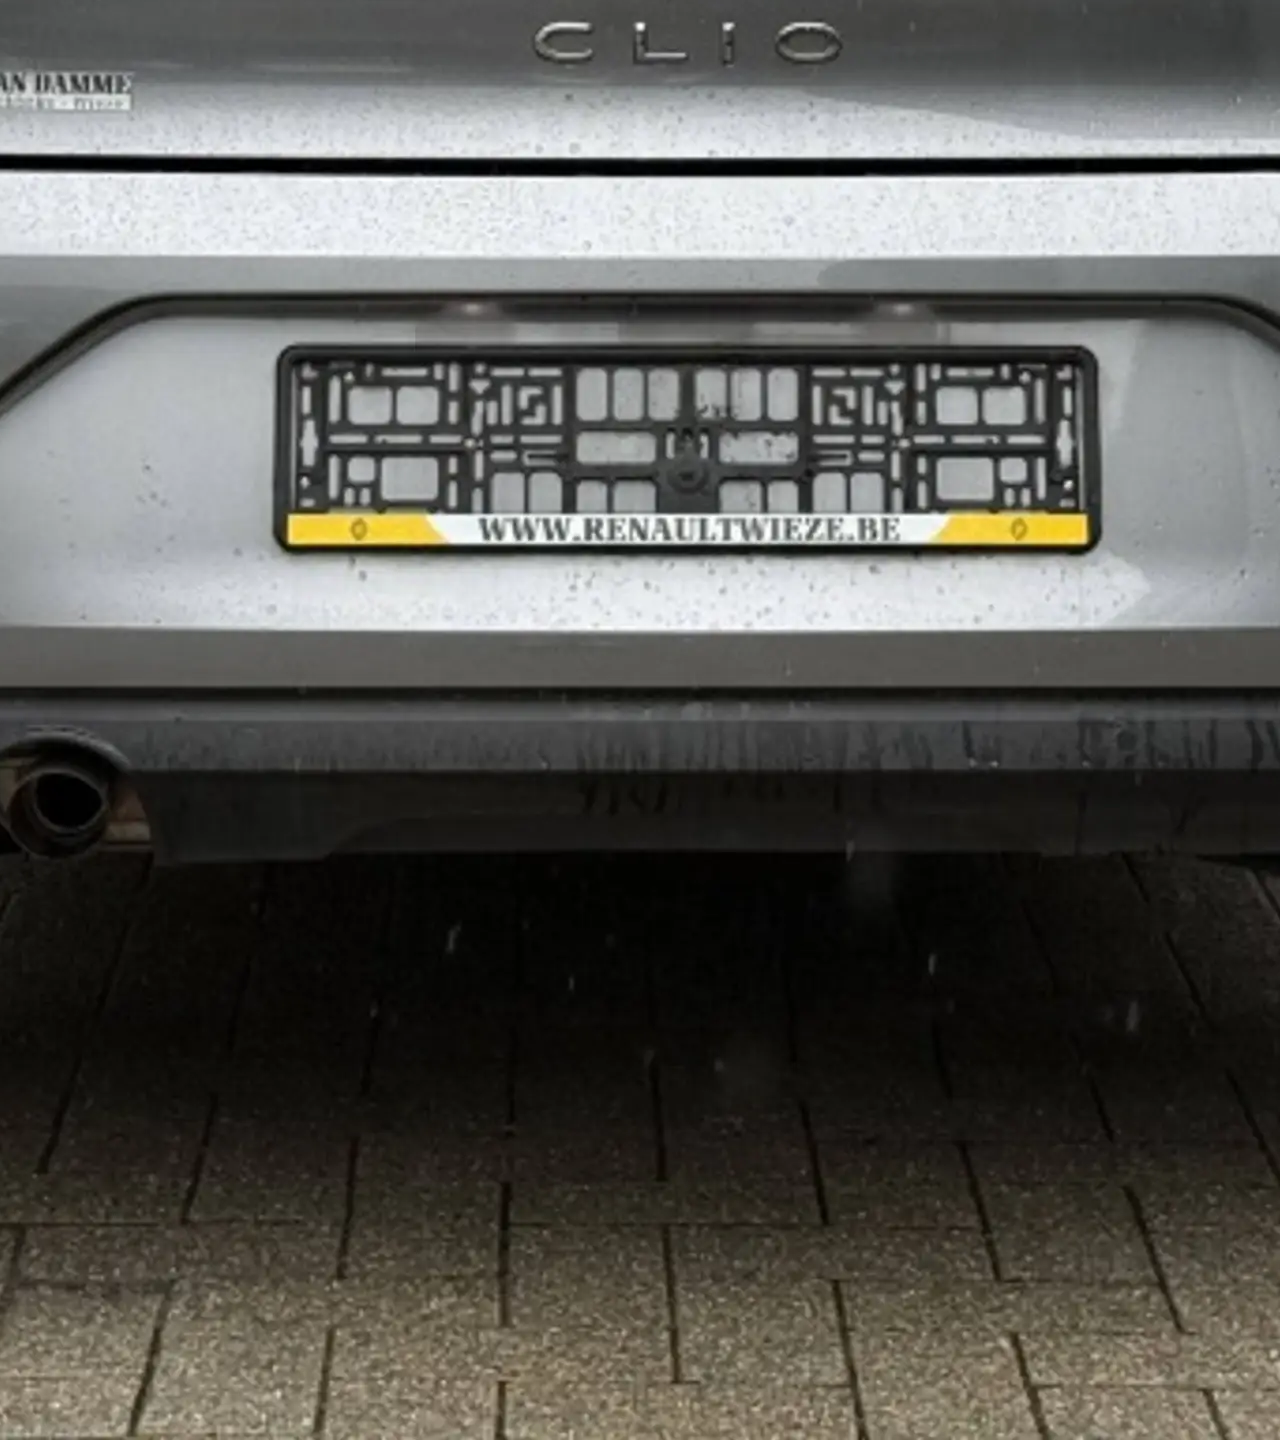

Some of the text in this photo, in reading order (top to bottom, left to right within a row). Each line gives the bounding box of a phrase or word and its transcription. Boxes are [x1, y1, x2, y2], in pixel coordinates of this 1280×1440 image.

[533, 21, 844, 67] CLIO
[35, 71, 134, 95] DAMME
[478, 517, 902, 543] WWW.RENAULTWIEZE.BE
